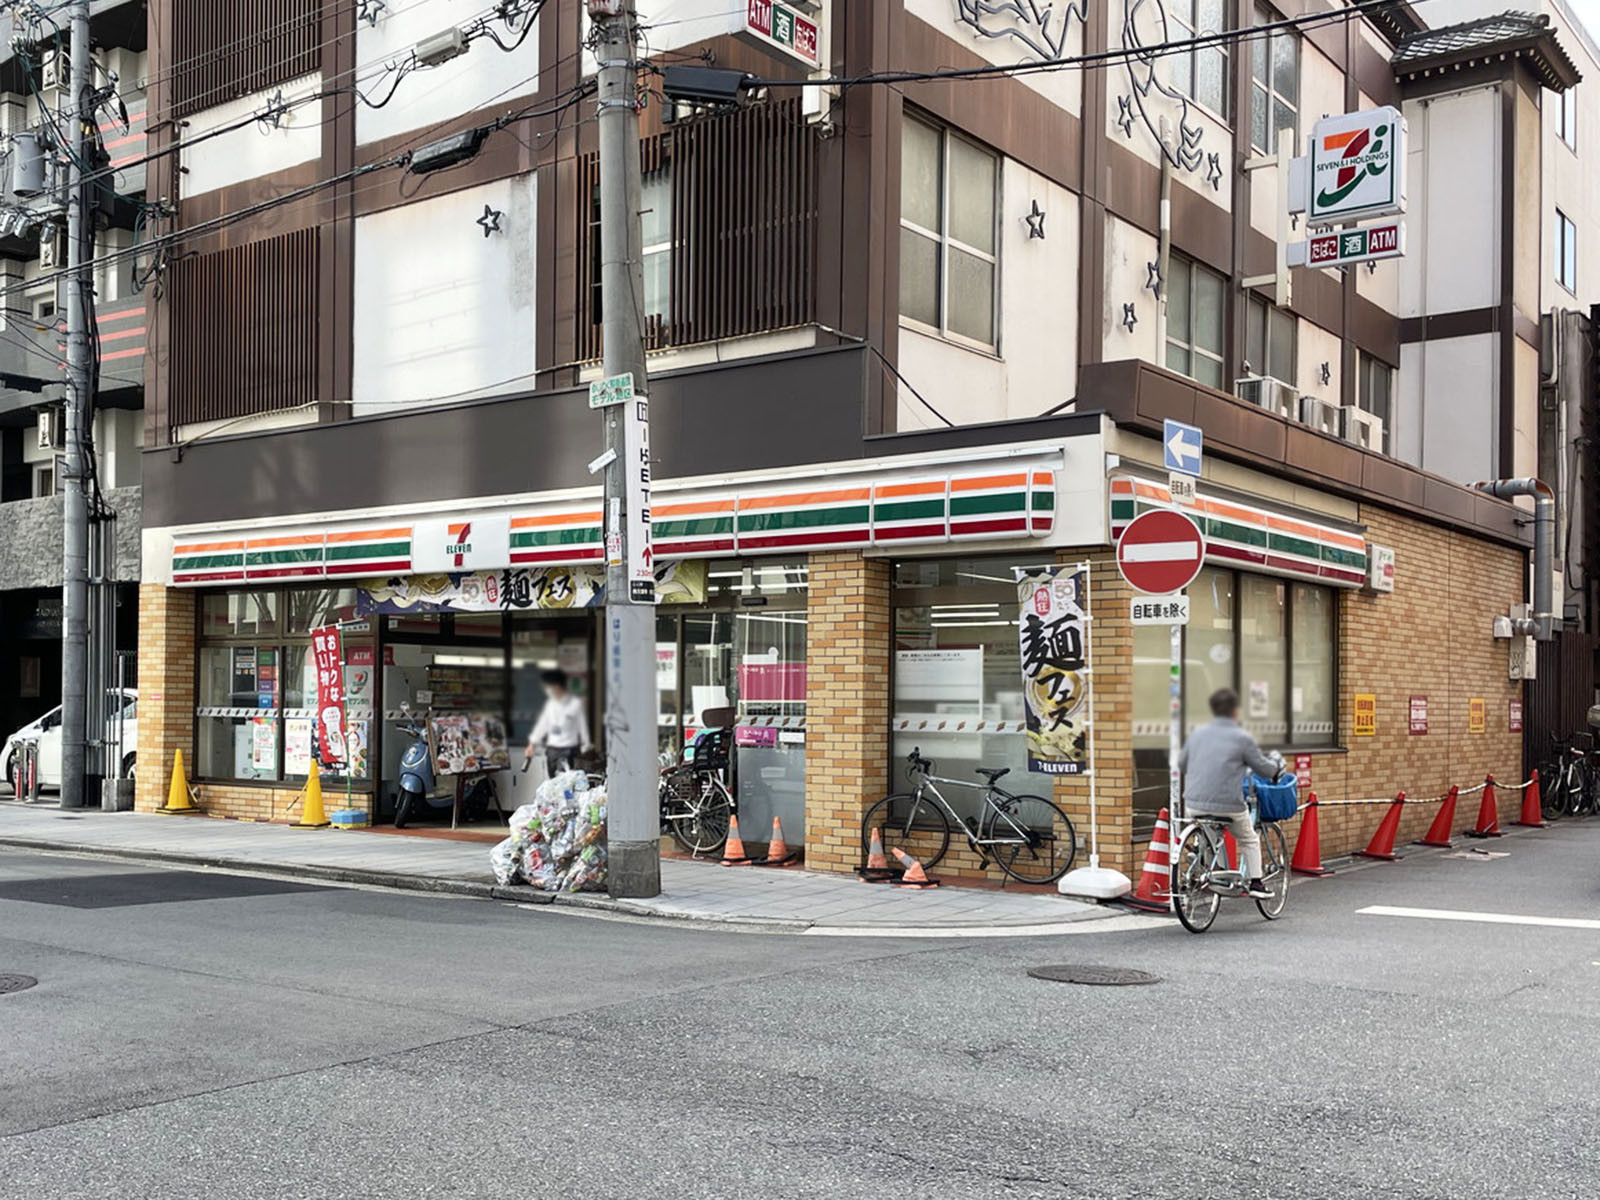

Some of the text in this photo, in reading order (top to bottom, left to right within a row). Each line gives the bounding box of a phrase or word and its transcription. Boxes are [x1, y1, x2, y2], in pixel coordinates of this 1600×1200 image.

[749, 0, 770, 31] ATM
[776, 11, 791, 41] 酒
[796, 23, 816, 55] たばこ
[1350, 151, 1389, 166] HOLDINGS
[1311, 234, 1362, 260] たばこ 酒
[1370, 229, 1396, 250] ATM
[500, 568, 573, 611] 麺フェス
[1055, 585, 1074, 600] 50
[1133, 603, 1187, 620] 自転車を除く
[327, 635, 339, 702] おトクな
[353, 651, 370, 660] ATM
[1021, 612, 1085, 732] 麺フェス
